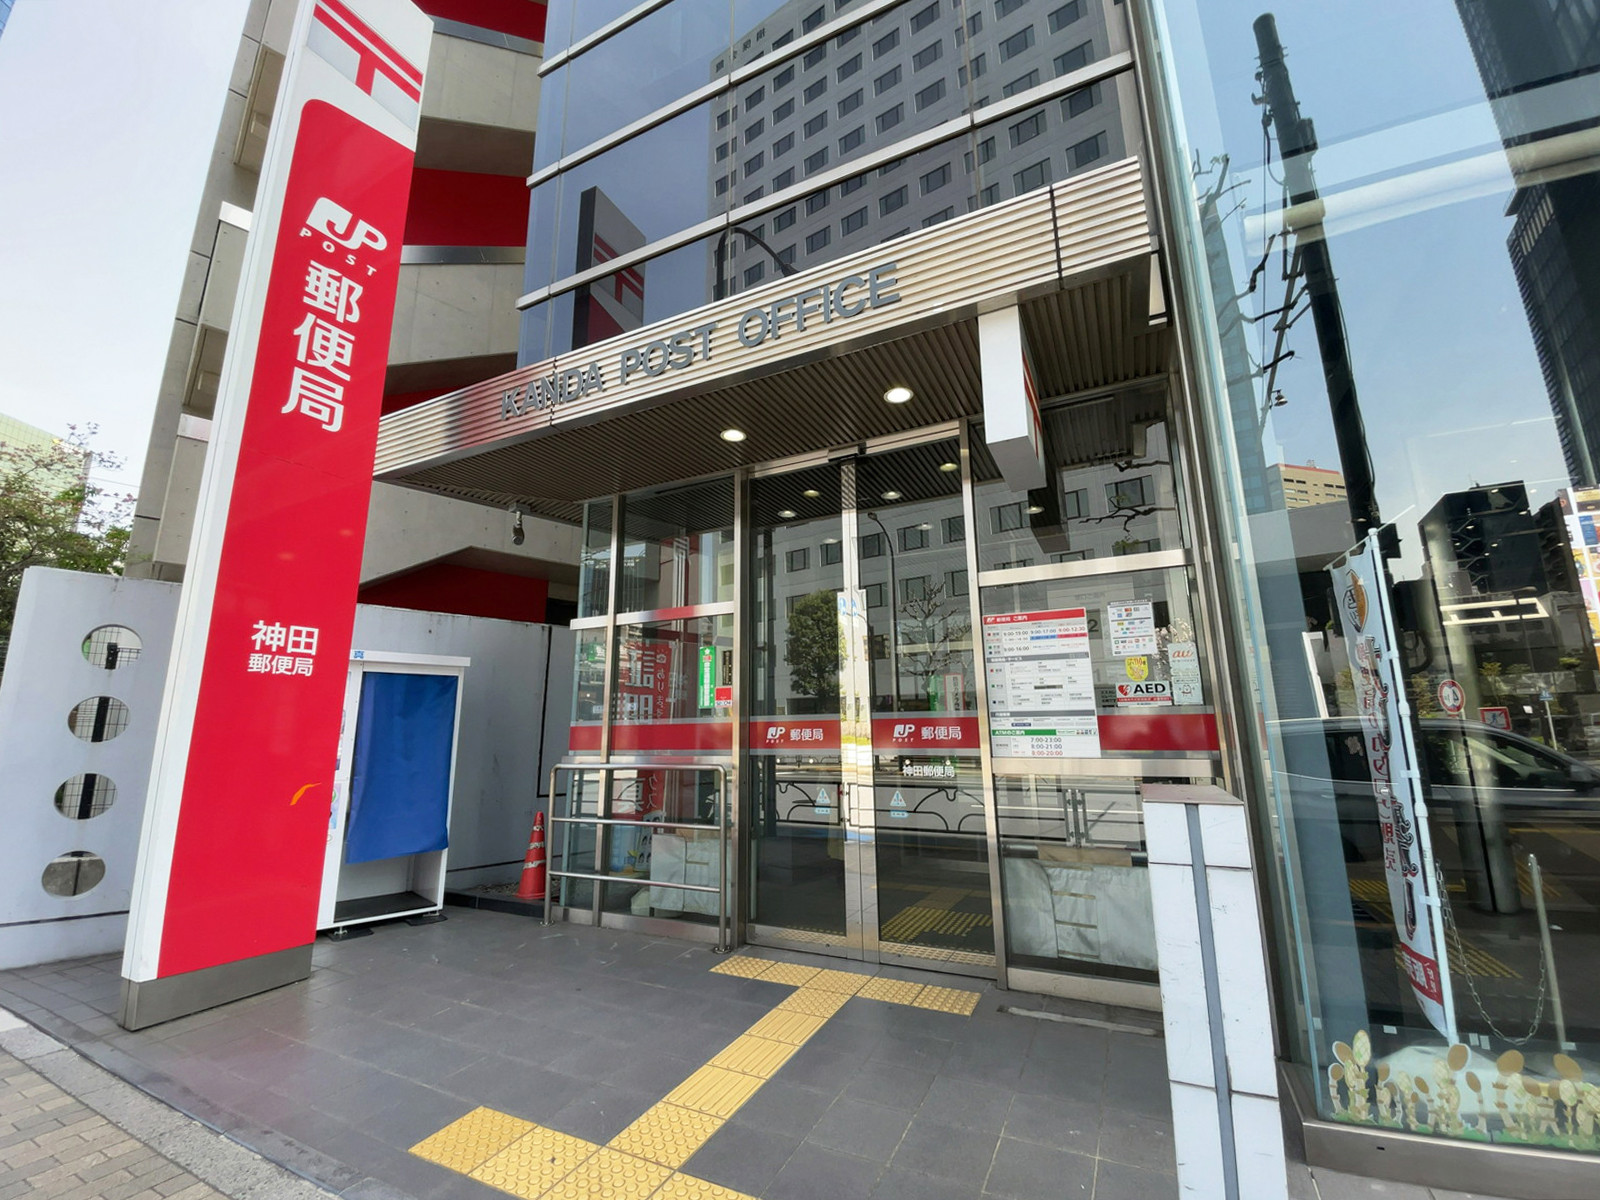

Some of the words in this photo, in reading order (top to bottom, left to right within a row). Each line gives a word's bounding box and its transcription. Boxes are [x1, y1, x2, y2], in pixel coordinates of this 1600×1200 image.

[306, 197, 388, 251] JP
[299, 227, 377, 276] POST
[281, 260, 363, 433] 郵便局
[500, 362, 605, 420] KANDA
[620, 322, 718, 384] POST
[737, 263, 901, 348] OFFICE
[251, 620, 319, 656] 神田
[247, 653, 313, 676] 郵便局
[1172, 649, 1195, 658] au
[1133, 683, 1166, 694] AED
[789, 728, 824, 741] 郵便局
[920, 726, 961, 740] 郵便局
[902, 765, 955, 778] 神田郵便局
